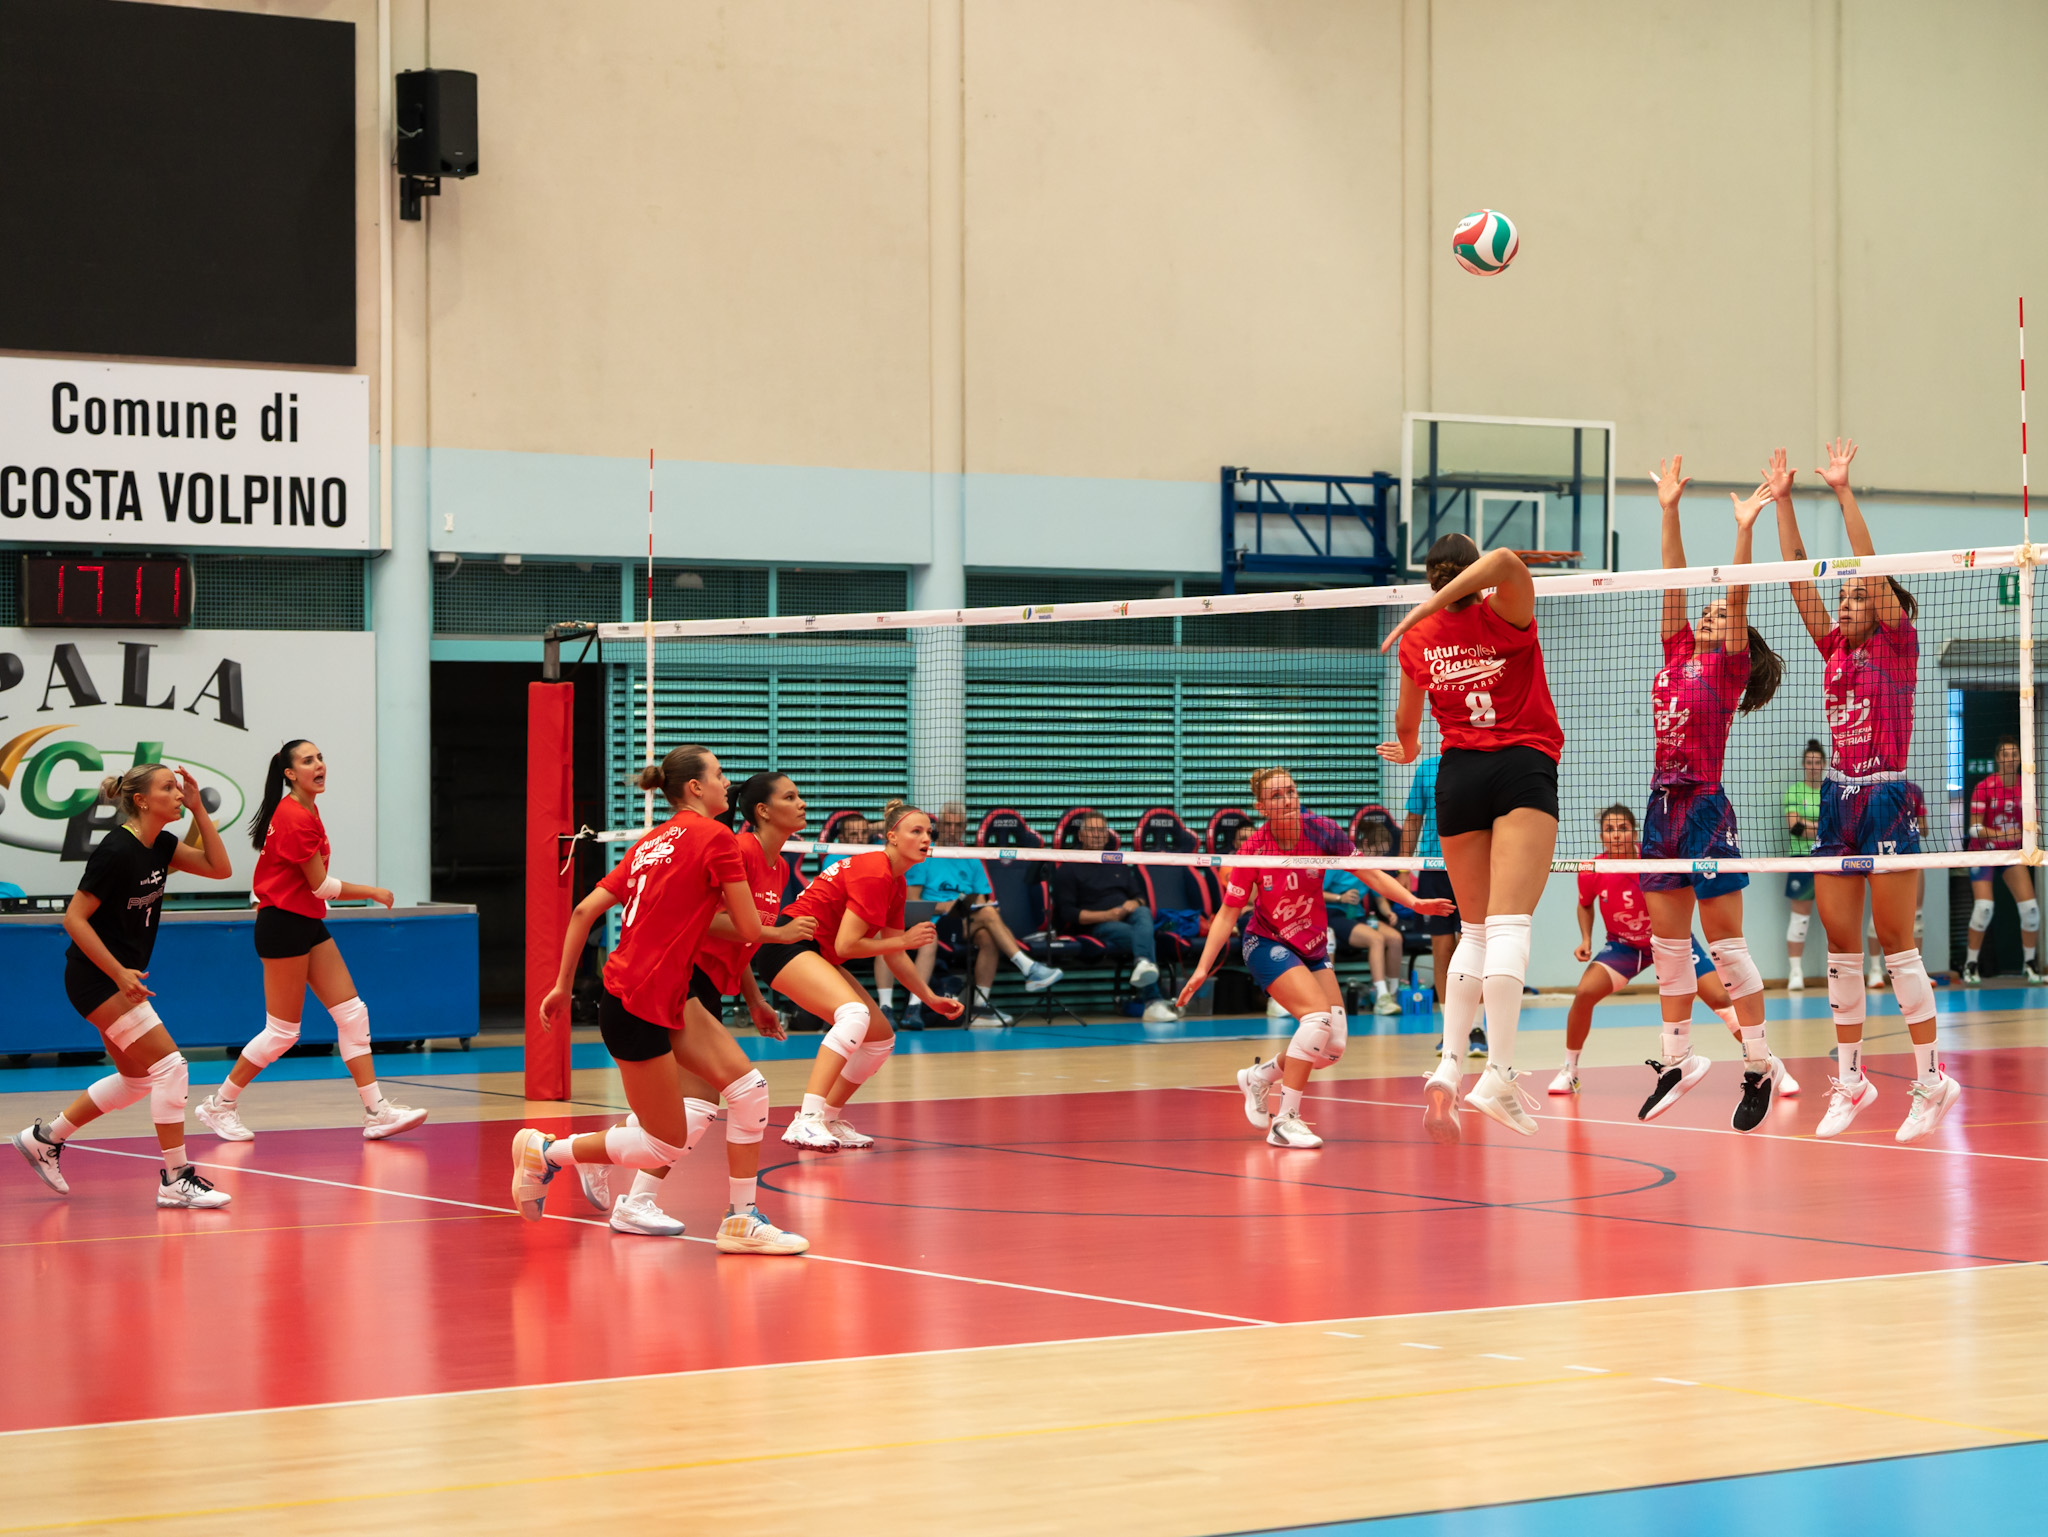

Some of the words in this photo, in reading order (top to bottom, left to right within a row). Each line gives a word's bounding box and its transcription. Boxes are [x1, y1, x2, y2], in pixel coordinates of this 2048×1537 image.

[52, 381, 237, 441] Comune
[260, 392, 299, 443] di
[0, 464, 143, 521] COSTA
[158, 472, 348, 529] VOLPINO
[1832, 558, 1861, 569] SANDRINI
[1428, 682, 1466, 692] BUSTO
[1473, 665, 1507, 690] ARSIZ
[1102, 854, 1122, 863] FINECO
[1843, 859, 1873, 869] FINECO
[1622, 890, 1635, 910] 5
[1304, 931, 1327, 951] VEKA
